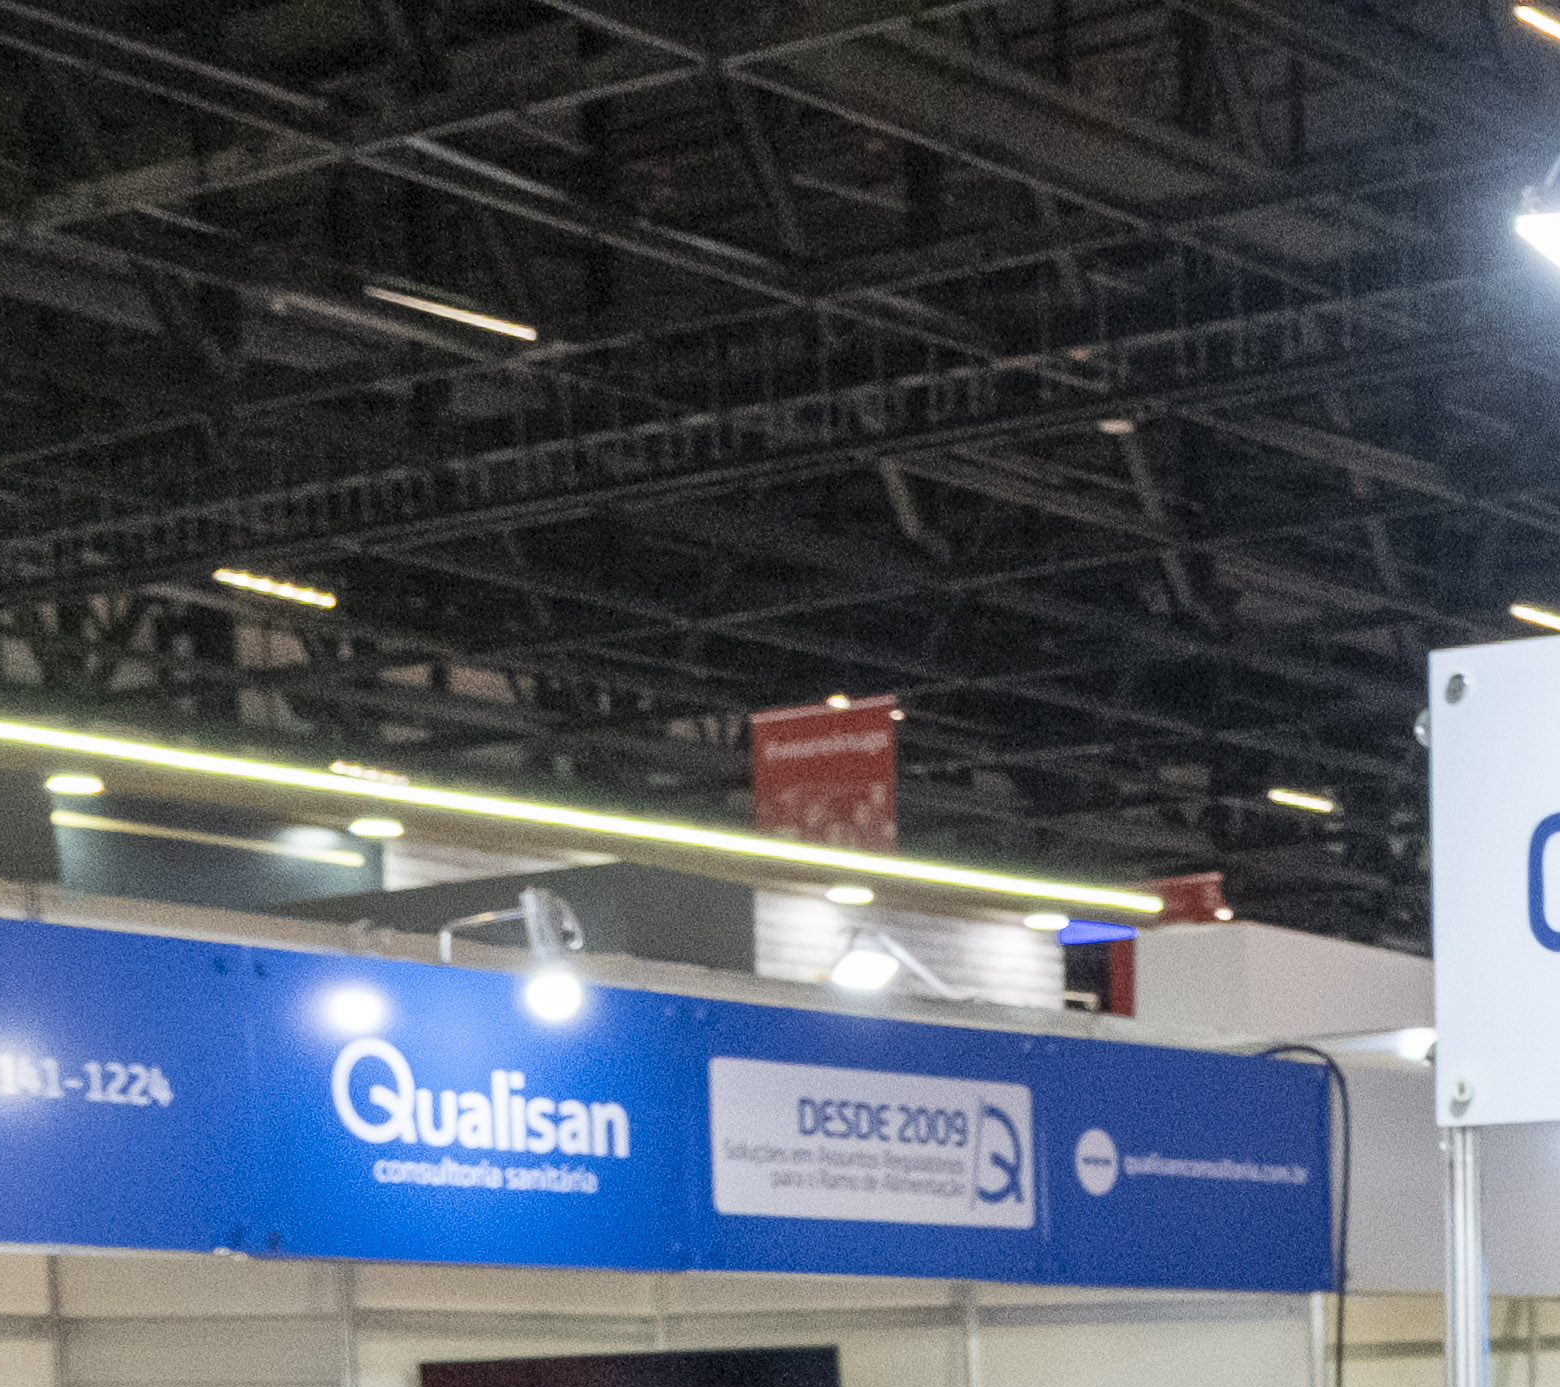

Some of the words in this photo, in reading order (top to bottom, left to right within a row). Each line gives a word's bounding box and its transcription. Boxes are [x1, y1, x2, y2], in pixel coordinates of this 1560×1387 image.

[331, 1036, 631, 1159] Qualisan
[797, 1097, 890, 1142] DESDE
[897, 1103, 969, 1148] 2009
